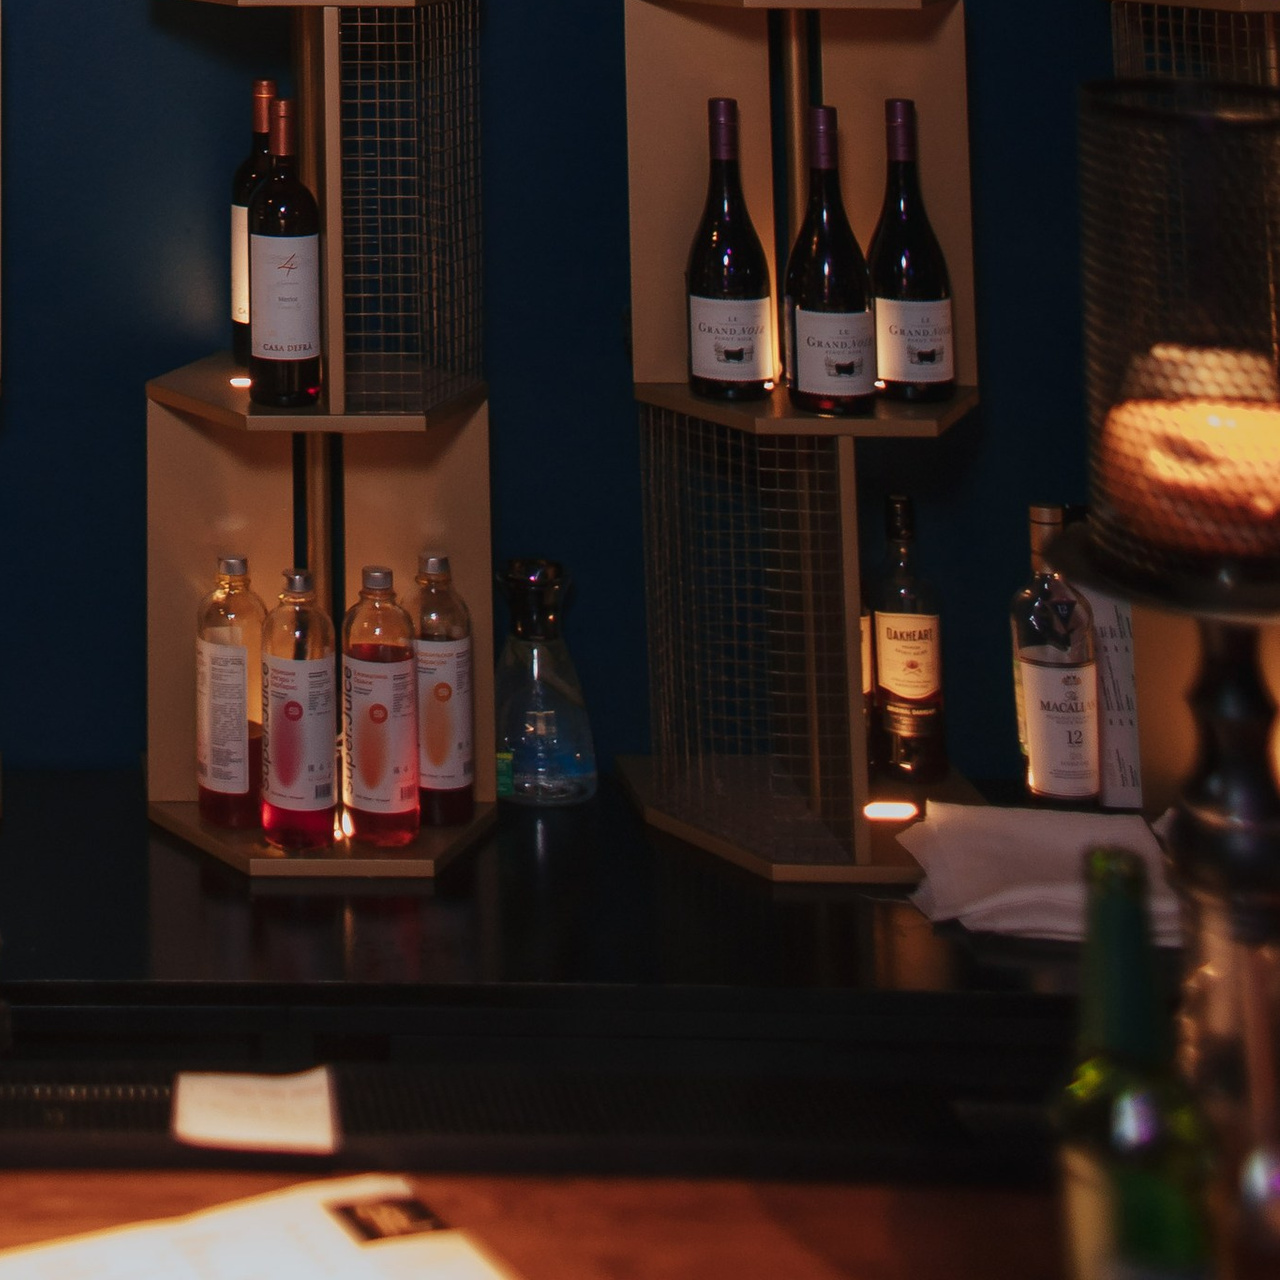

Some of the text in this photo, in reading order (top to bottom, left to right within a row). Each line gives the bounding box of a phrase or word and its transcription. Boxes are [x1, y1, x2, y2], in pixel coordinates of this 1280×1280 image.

[277, 253, 297, 277] 4
[698, 322, 737, 335] GRAND
[888, 324, 929, 337] GRAND
[263, 343, 285, 351] CASA
[806, 336, 848, 349] GRAND
[886, 626, 933, 642] OAKHEART
[1067, 730, 1083, 744] 12
